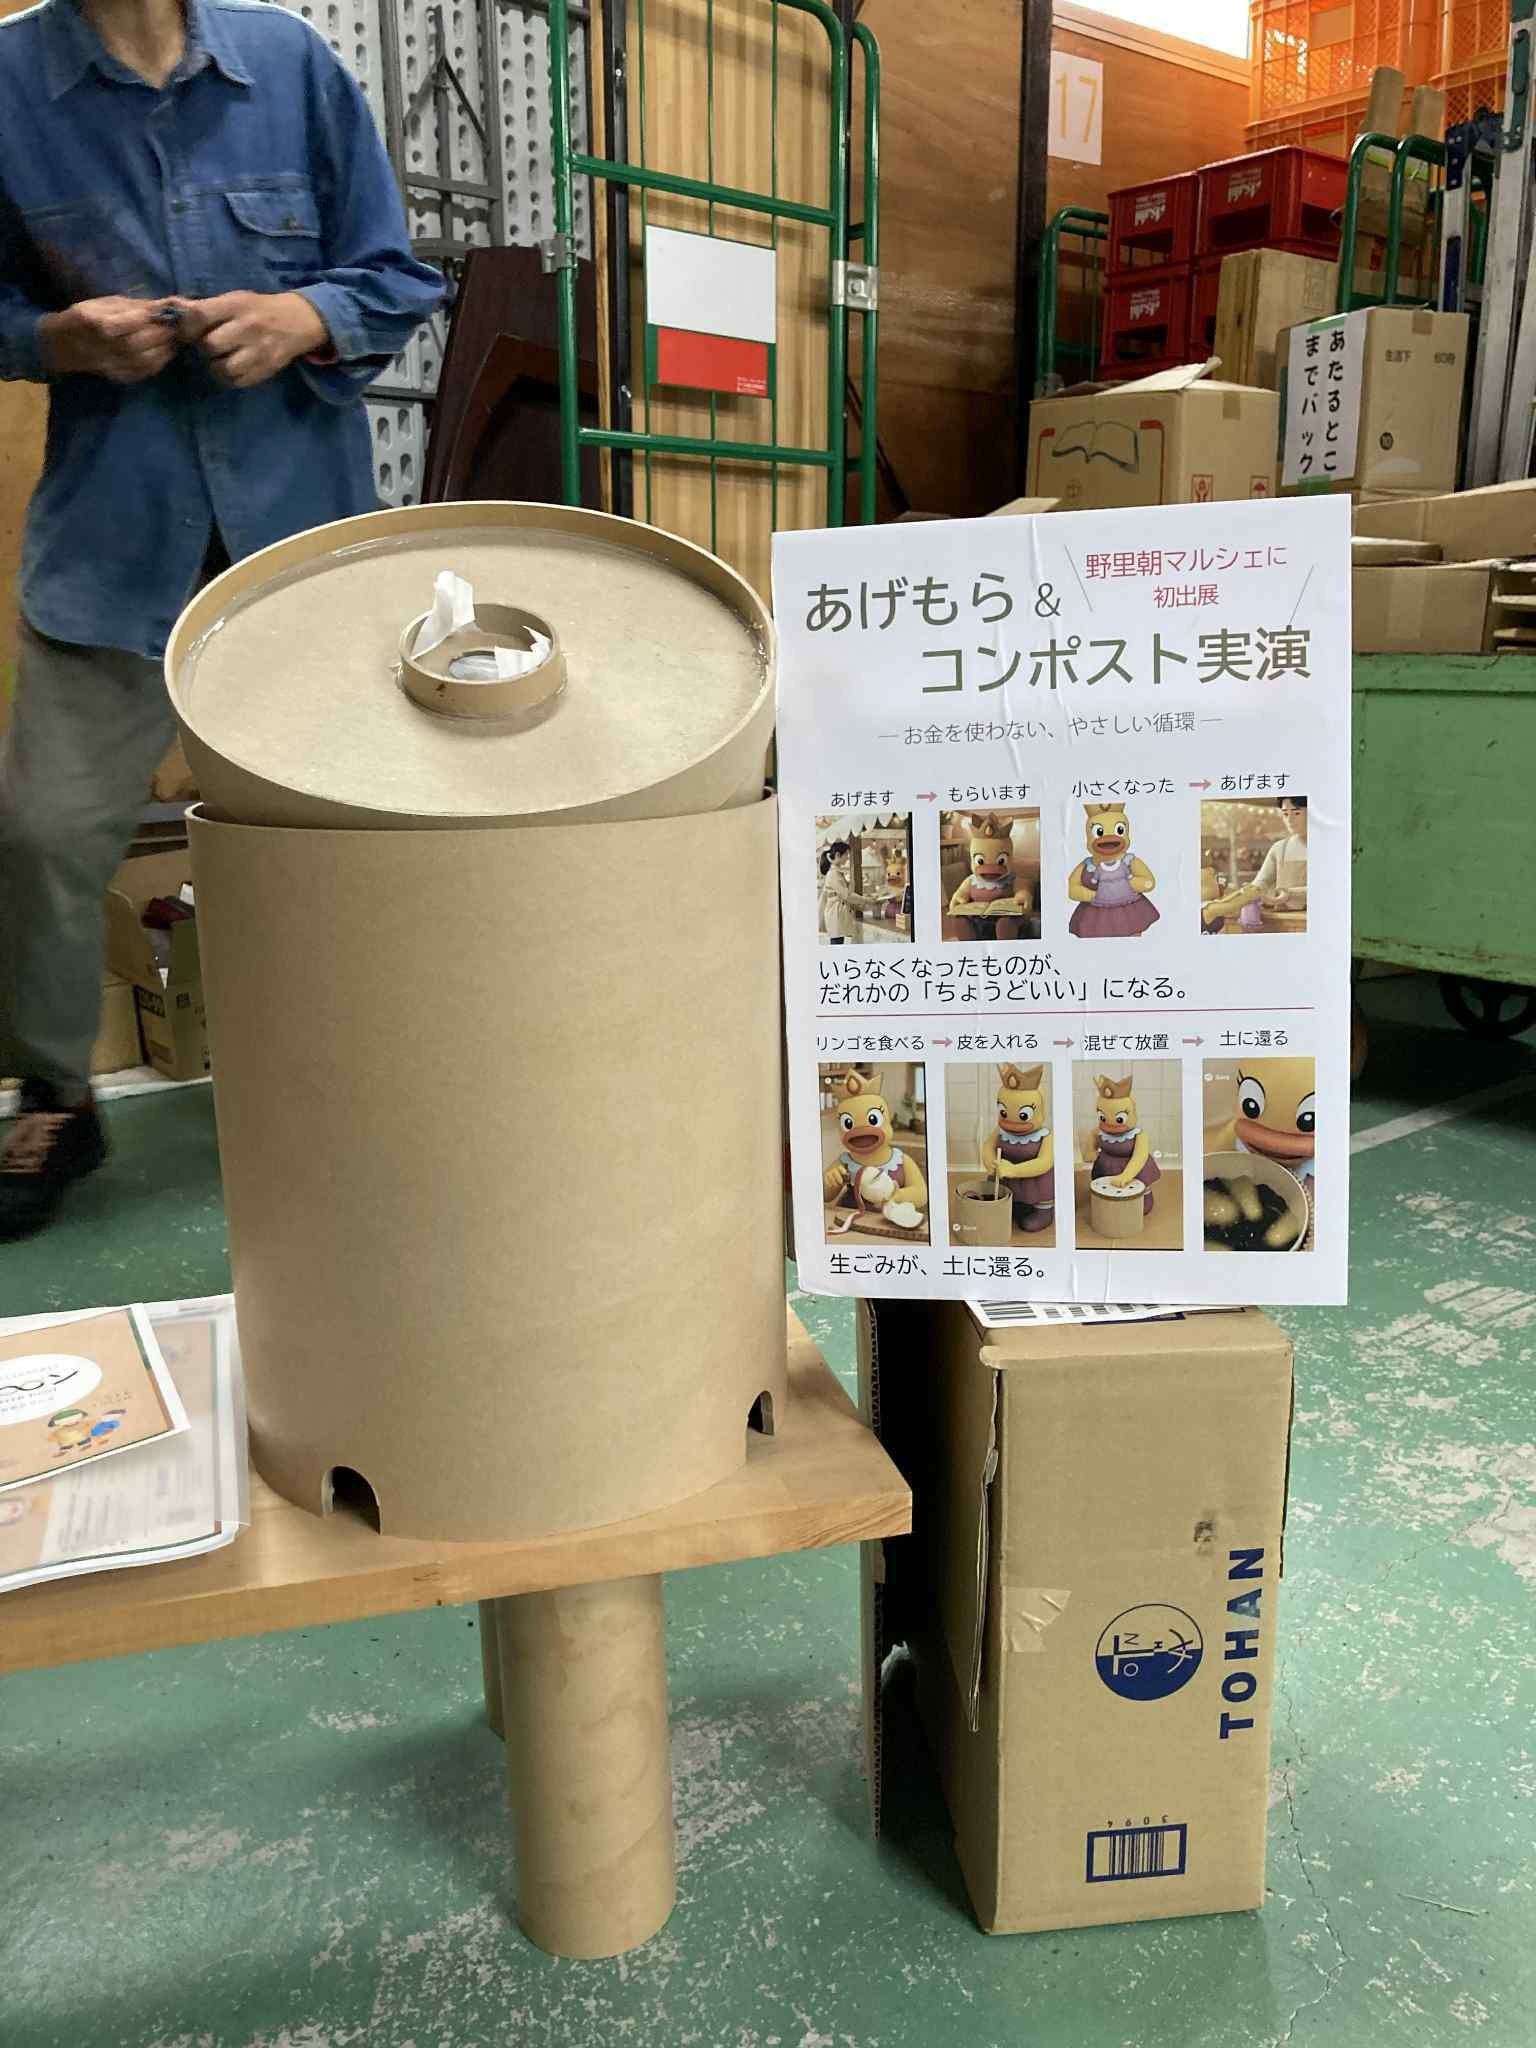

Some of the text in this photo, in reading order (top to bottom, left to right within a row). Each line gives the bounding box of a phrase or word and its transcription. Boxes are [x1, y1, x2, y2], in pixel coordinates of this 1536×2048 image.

[1056, 71, 1097, 144] 17
[1323, 329, 1346, 472] あたるとこ
[1085, 546, 1288, 581] 野里朝マルシェに
[805, 572, 1064, 633] あげもら &
[1153, 584, 1220, 609] 初出展
[921, 625, 1313, 694] コンポスト実演
[903, 711, 1196, 746] お金を使わない、やさしい循環
[831, 783, 1032, 808] あげます もらいます
[1071, 772, 1291, 799] 小さくなった あげます
[819, 953, 1062, 979] いらなくなったものが、
[819, 976, 1188, 1005] だれかの「ちょうどいい」になる。
[815, 1029, 1290, 1053] リンゴを食べる 皮を入れる 混ぜて放置 土に還る
[829, 1253, 1048, 1279] 生ごみが、土に還る。
[1219, 1548, 1264, 1739] TOHAN
